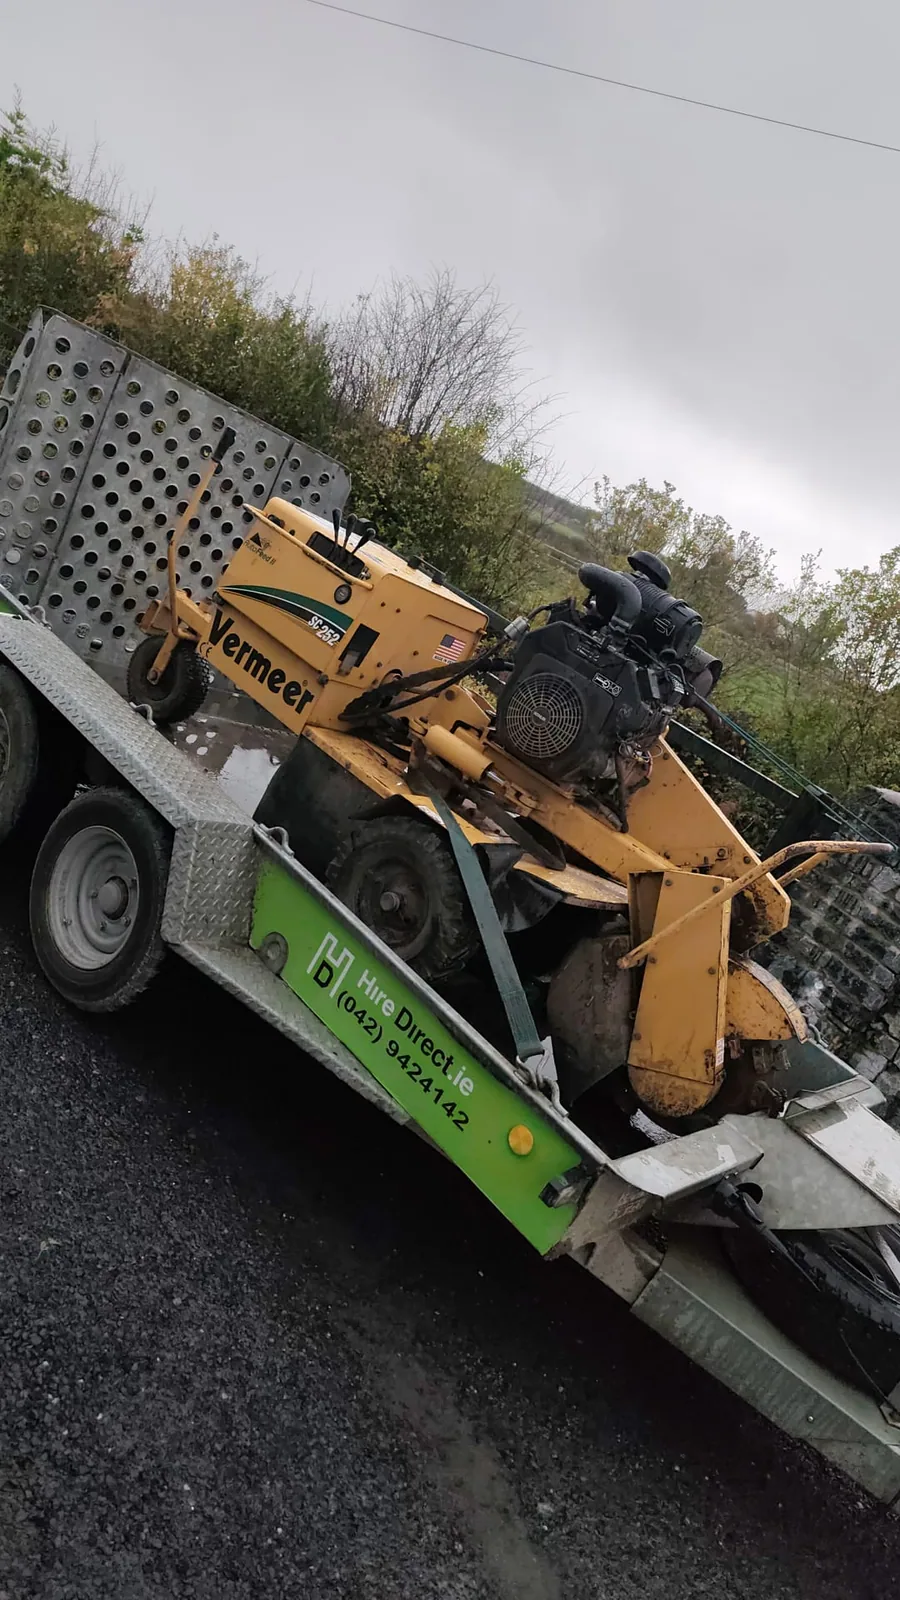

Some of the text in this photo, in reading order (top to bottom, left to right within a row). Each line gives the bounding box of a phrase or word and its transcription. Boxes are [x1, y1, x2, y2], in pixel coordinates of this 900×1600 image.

[208, 608, 315, 714] Vermeer
[356, 969, 396, 1017] Hire
[336, 990, 470, 1132] (042) 9424142
